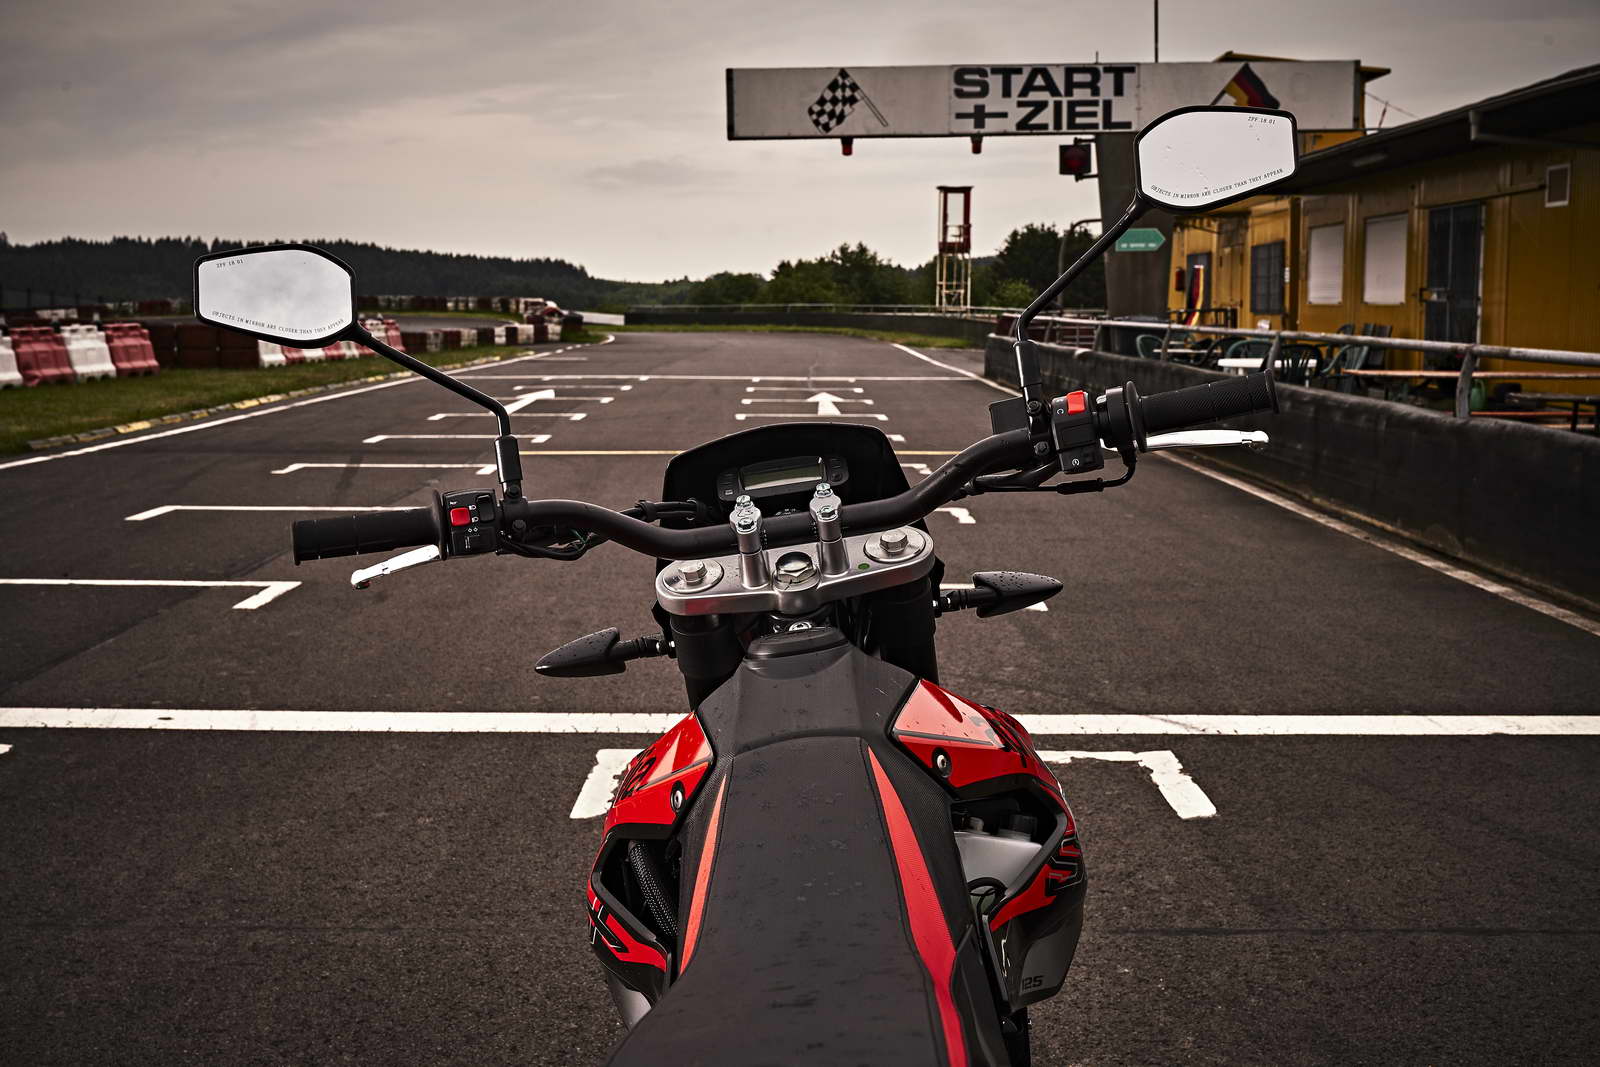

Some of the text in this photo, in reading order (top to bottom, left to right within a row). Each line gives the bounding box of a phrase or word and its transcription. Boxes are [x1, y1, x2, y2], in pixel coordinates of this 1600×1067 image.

[953, 66, 1136, 99] START
[1151, 184, 1171, 197] OBJECTS
[1212, 184, 1232, 194] CLOSER
[1233, 180, 1248, 188] THAN
[1248, 175, 1262, 184] THEY
[1263, 167, 1283, 179] APPEAR
[212, 310, 235, 321] OBJECTS
[245, 319, 265, 327] MIRROR
[278, 326, 298, 334] CLOSER
